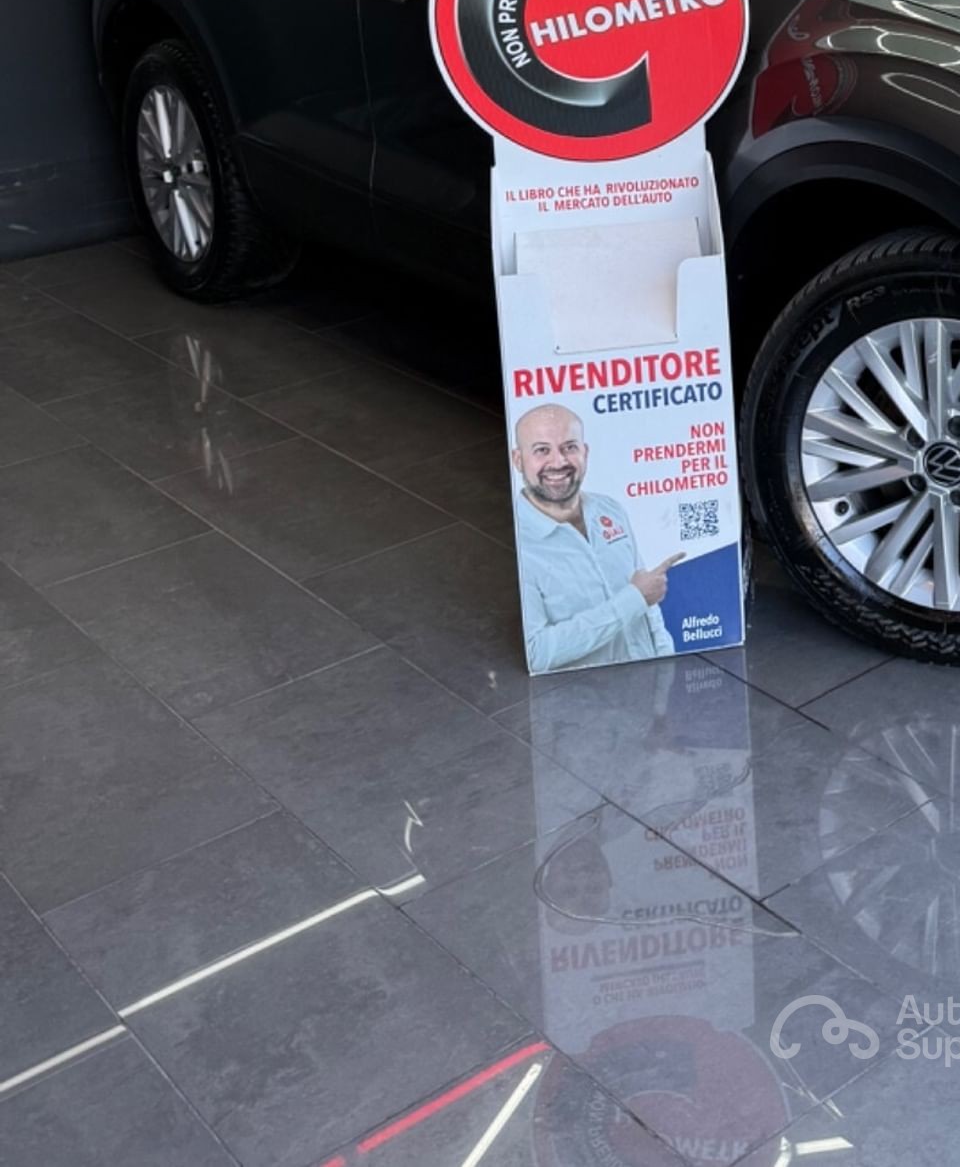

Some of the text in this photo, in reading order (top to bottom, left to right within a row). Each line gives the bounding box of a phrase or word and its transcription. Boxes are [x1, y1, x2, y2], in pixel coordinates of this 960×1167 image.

[500, 27, 531, 69] NON
[505, 176, 700, 203] IL LIBRO CHE HA RIVOLUZIONATO
[538, 191, 673, 213] IL MERCATO DELL'AUTO
[512, 347, 722, 397] RIVENDITORE
[593, 381, 723, 414] CERTIFICATO
[690, 421, 725, 438] NON
[633, 439, 727, 463] PRENDERMI
[681, 455, 728, 474] PER IL
[626, 471, 728, 498] CHILOMETRO
[681, 613, 720, 629] Alfredo
[682, 626, 723, 643] Bellucci
